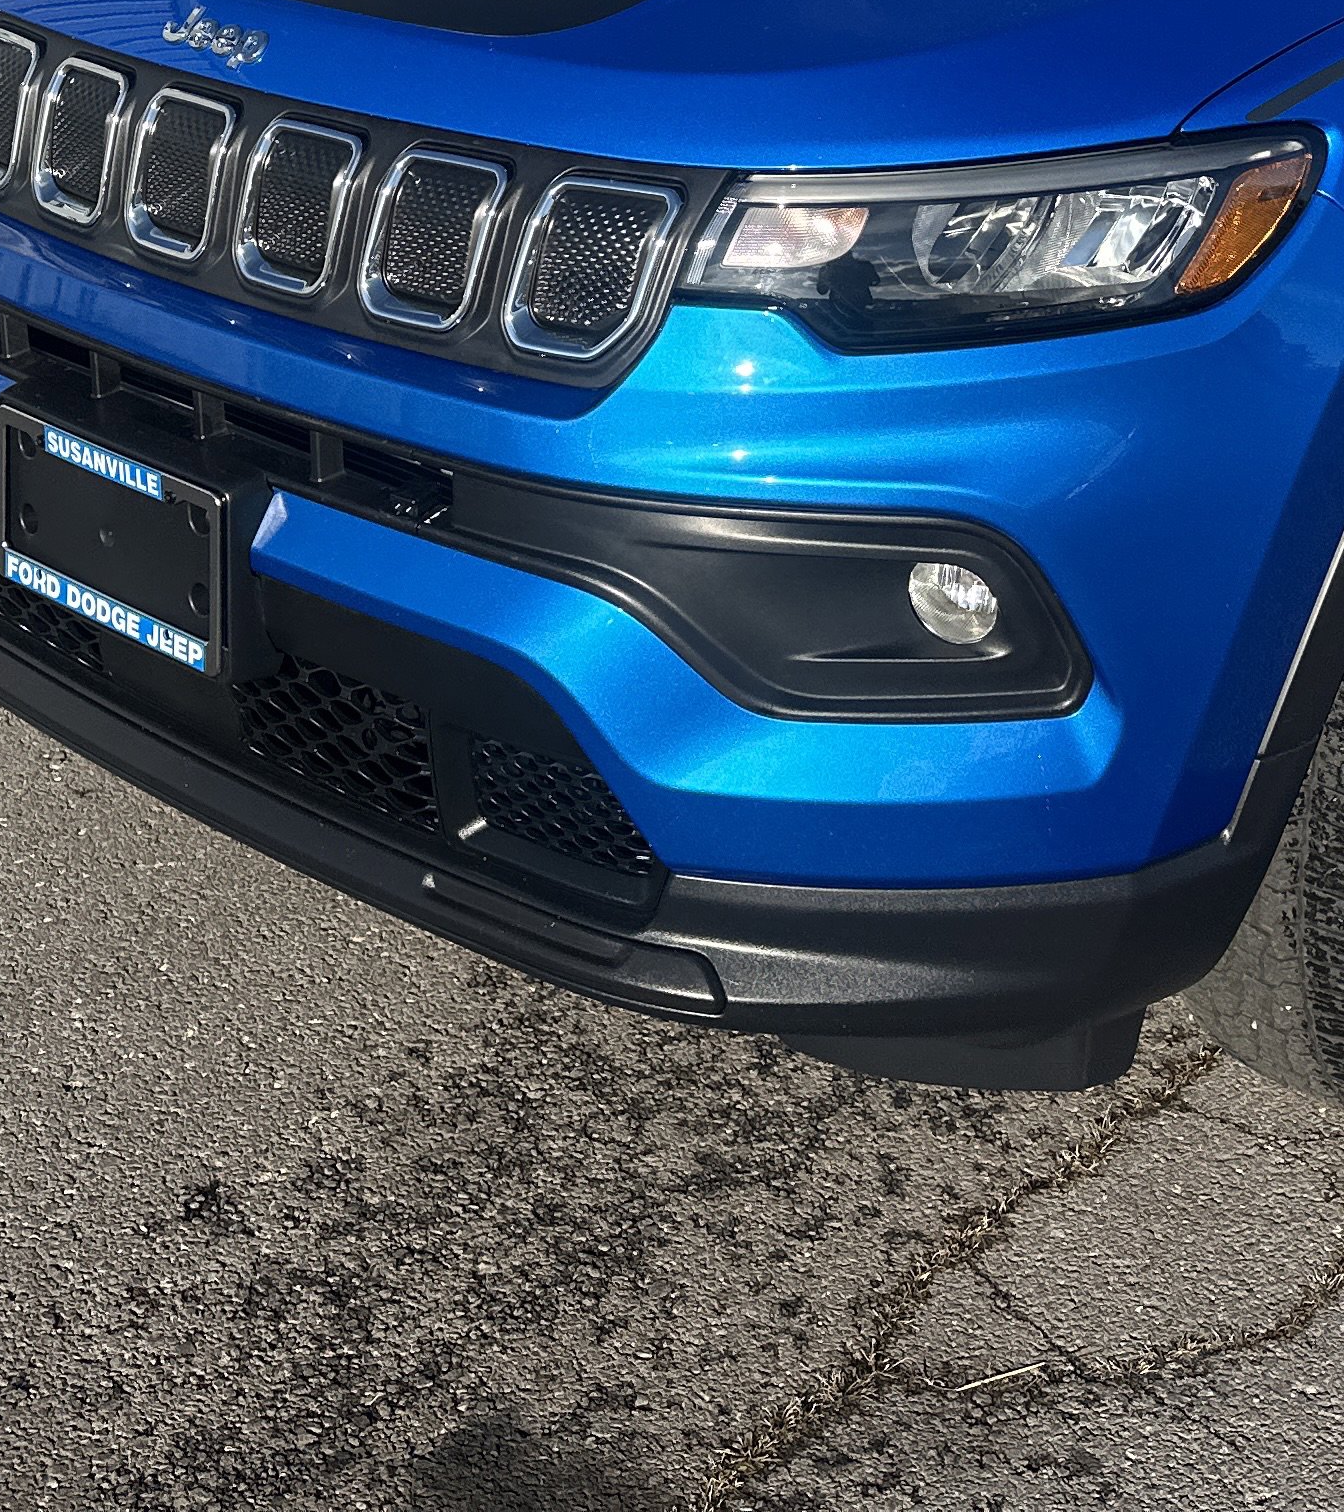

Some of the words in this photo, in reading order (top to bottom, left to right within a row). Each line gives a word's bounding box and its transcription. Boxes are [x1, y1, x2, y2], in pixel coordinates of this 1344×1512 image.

[162, 4, 271, 71] Jeep
[46, 430, 161, 497] SUSANVILLE
[6, 553, 61, 599] FORD
[66, 583, 141, 638] DODGE
[146, 623, 204, 666] JEEP
